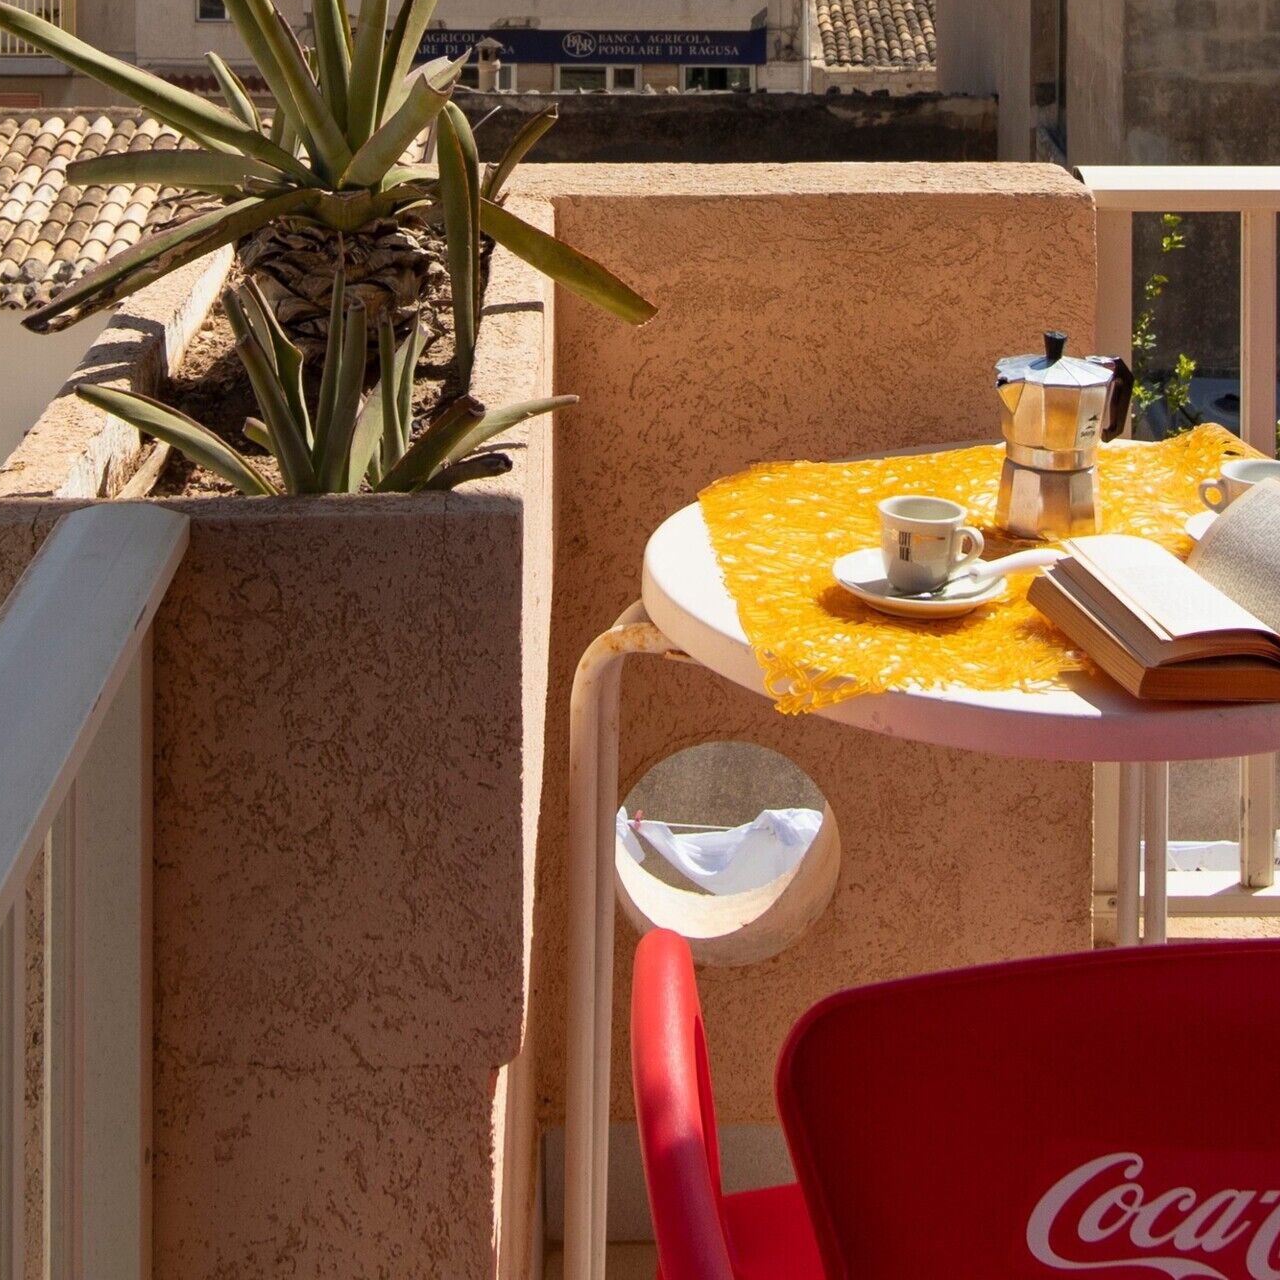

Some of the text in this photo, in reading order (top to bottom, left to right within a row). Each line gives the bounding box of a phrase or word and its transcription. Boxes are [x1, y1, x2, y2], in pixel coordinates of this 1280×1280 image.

[598, 33, 711, 44] BANCA AGRICOLA
[445, 44, 458, 55] DI
[598, 45, 740, 56] POPOLARE DI RAGUSA
